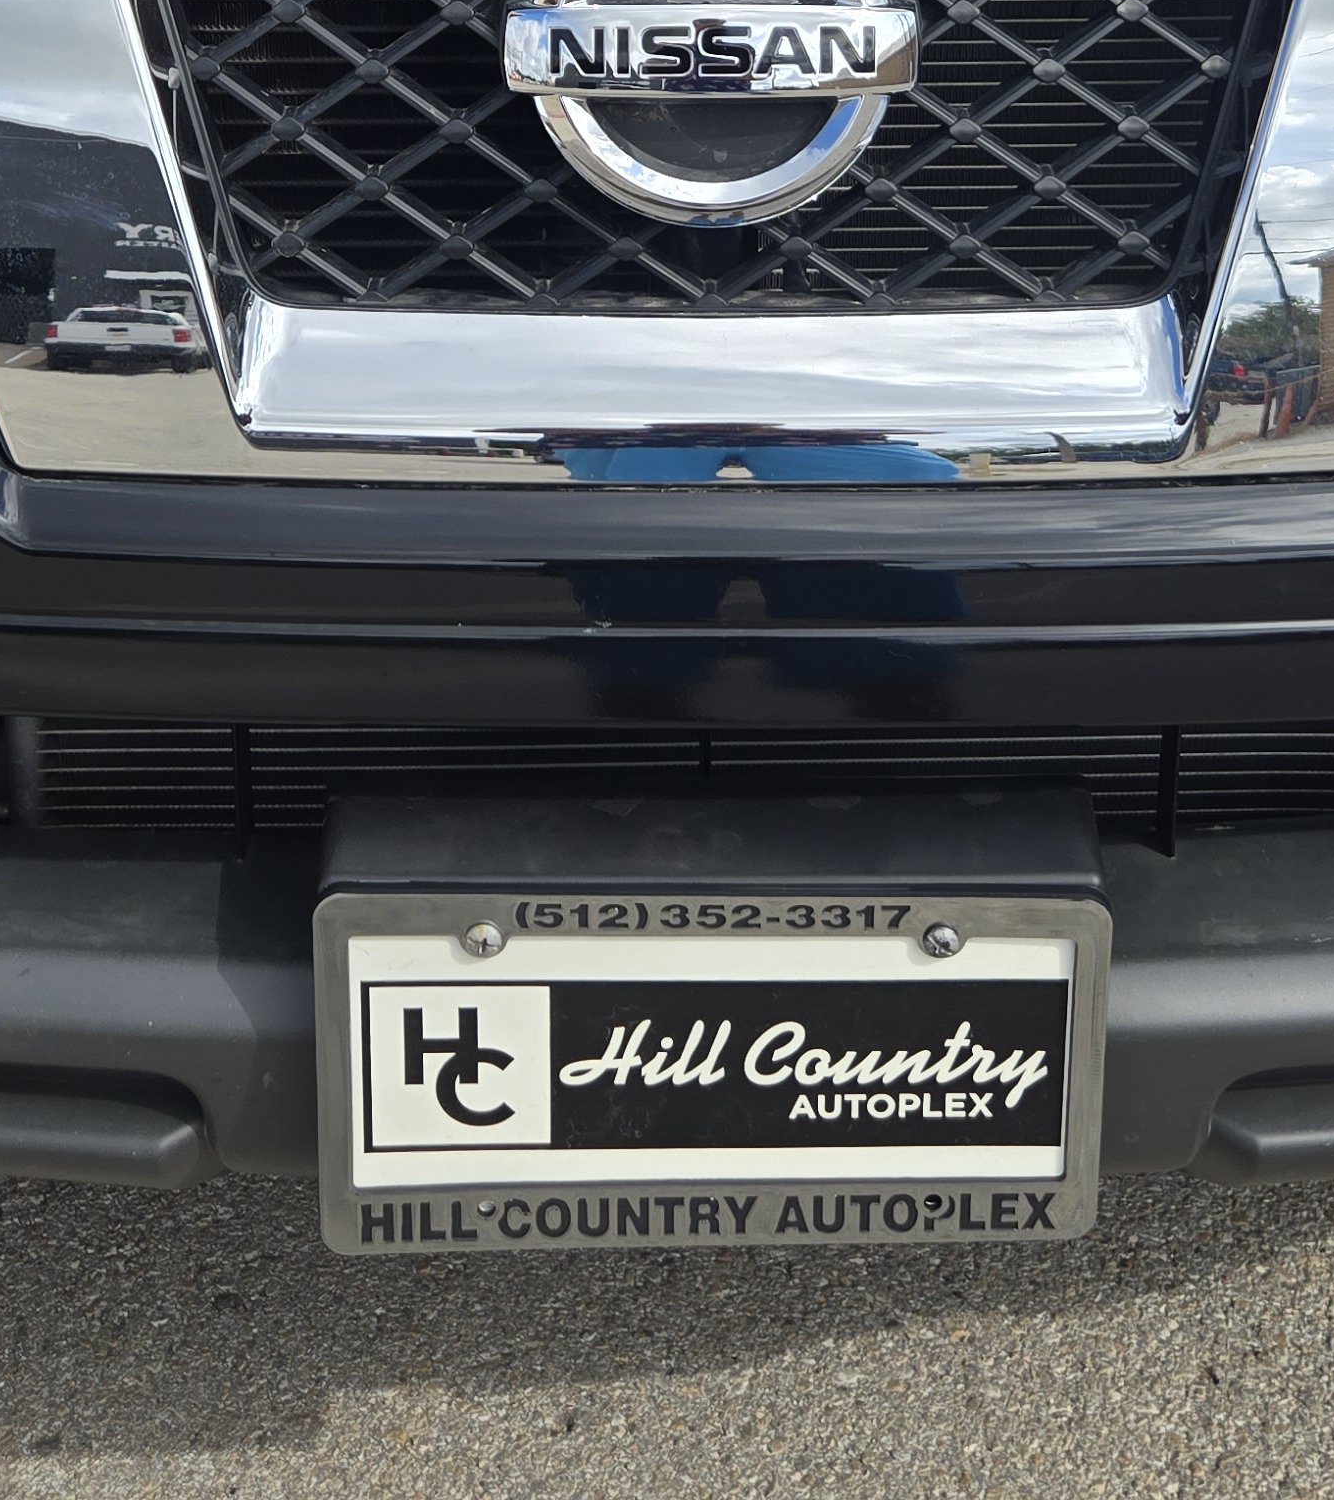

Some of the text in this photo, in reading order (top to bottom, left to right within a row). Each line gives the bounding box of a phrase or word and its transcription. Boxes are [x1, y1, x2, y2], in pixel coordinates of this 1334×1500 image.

[549, 25, 877, 76] NISSAN
[558, 1019, 1049, 1110] Hill Country
[788, 1092, 994, 1120] AUTOPLEX
[360, 1200, 478, 1244] HILL
[497, 1195, 758, 1240] COUNTRY
